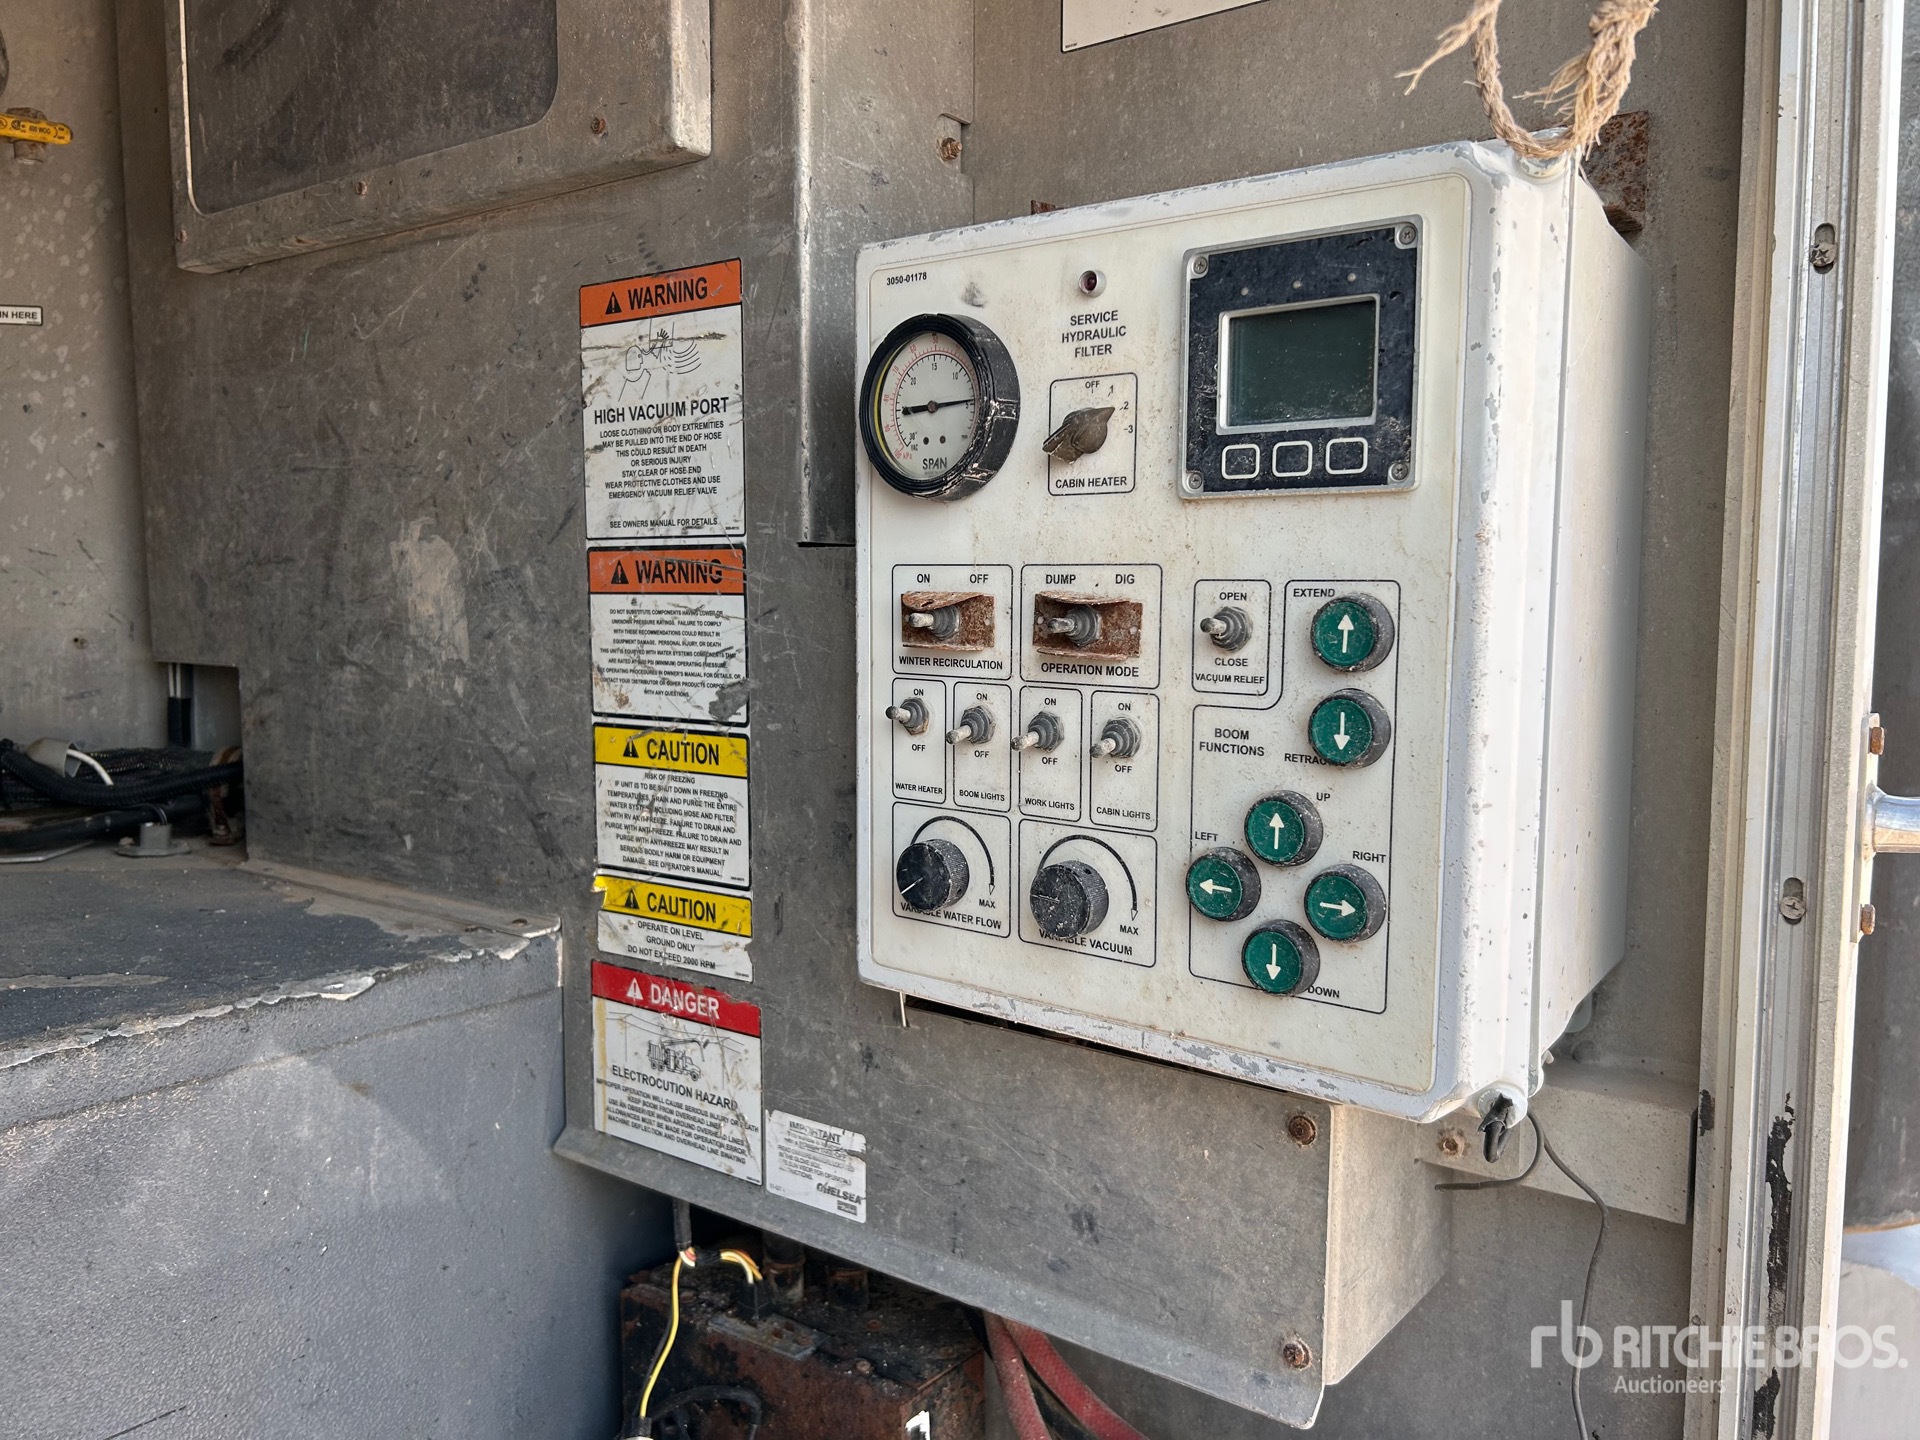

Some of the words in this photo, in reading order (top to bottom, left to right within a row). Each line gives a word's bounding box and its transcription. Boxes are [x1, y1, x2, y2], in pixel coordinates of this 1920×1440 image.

[887, 272, 927, 286] 3050-01178
[628, 277, 707, 310] WARNING
[11, 311, 38, 319] HERE
[1070, 310, 1119, 326] SERVICE
[1061, 326, 1127, 343] HYDRAULIC
[1074, 344, 1112, 358] FILTER
[931, 362, 938, 371] 15
[952, 372, 958, 381] 10
[1085, 381, 1100, 390] OFF
[1109, 385, 1114, 394] 1
[594, 407, 625, 425] HIGH
[629, 401, 686, 421] VACUUM
[691, 396, 729, 415] PORT
[1123, 401, 1129, 410] 2
[600, 430, 620, 438] LOOSE
[621, 427, 652, 437] CLOTHING
[652, 426, 662, 434] OR
[663, 424, 681, 433] BODY
[682, 420, 724, 431] EXTREMITIES
[1127, 425, 1134, 434] 3
[602, 440, 614, 448] MAY
[625, 438, 648, 446] PULLED
[650, 436, 664, 445] INTO
[665, 435, 678, 443] THE
[679, 434, 692, 442] END
[694, 433, 702, 441] OF
[704, 431, 722, 440] HOSE
[616, 449, 630, 458] THIS
[630, 447, 652, 457] COULD
[653, 446, 677, 455] RESULT
[678, 445, 684, 453] IN
[686, 444, 707, 453] DEATH
[630, 459, 640, 467] OR
[641, 457, 668, 467] SERIOUS
[669, 455, 691, 465] INJURY
[922, 457, 948, 470] SPAN
[622, 470, 637, 478] STAY
[637, 468, 658, 477] CLEAR
[660, 467, 668, 476] OF
[669, 466, 687, 475] HOSE
[688, 465, 702, 474] END
[605, 481, 623, 489] WEAR
[624, 478, 661, 488] PROTECTIVE
[662, 477, 692, 486] CLOTHES
[692, 476, 707, 485] AND
[707, 475, 721, 484] USE
[1055, 478, 1085, 489] CABIN
[1088, 476, 1127, 487] HEATER
[609, 490, 646, 499] EMERGENCY
[647, 488, 672, 498] VACUUM
[674, 487, 696, 496] RELIEF
[697, 486, 718, 495] VALVE
[610, 520, 621, 529] SEE
[622, 519, 649, 528] OWNERS
[650, 518, 676, 527] MANUAL
[677, 518, 690, 527] FOR
[691, 517, 718, 526] DETAILS
[635, 559, 723, 584] WARNING
[917, 574, 931, 584] ON
[969, 574, 989, 584] OFF
[1045, 574, 1076, 585] DUMP
[1115, 574, 1135, 585] DIG
[1219, 592, 1247, 601] OPEN
[1293, 588, 1335, 598] EXTEND
[898, 656, 931, 667] WINTER
[933, 657, 1003, 670] RECIRCULATION
[1214, 657, 1248, 667] CLOSE
[1041, 662, 1102, 676] OPERATION
[1105, 665, 1139, 677] MODE
[1195, 673, 1232, 683] VACUUM
[1234, 675, 1265, 684] RELIEF
[913, 688, 924, 697] ON
[976, 692, 988, 701] ON
[1044, 697, 1057, 706] ON
[1118, 703, 1131, 712] ON
[1214, 728, 1250, 740] BOOM
[647, 738, 719, 766] CAUTION
[911, 743, 926, 752] OFF
[1199, 741, 1265, 757] FUNCTIONS
[974, 750, 989, 759] OFF
[1041, 756, 1058, 766] OFF
[1284, 753, 1332, 766] RETRAC
[1114, 764, 1132, 774] OFF
[644, 772, 658, 780] RISK
[658, 773, 666, 781] OF
[667, 774, 696, 784] FREEZING
[649, 783, 657, 791] BE
[657, 784, 673, 793] SHUT
[673, 786, 692, 795] DOWN
[692, 788, 699, 796] IN
[700, 789, 729, 799] FREEZING
[895, 782, 917, 792] WATER
[917, 784, 943, 795] HEATER
[959, 789, 980, 800] BOOM
[980, 791, 1005, 802] LIGHTS
[1316, 792, 1331, 802] UP
[1025, 797, 1048, 807] WORK
[1049, 800, 1075, 811] LIGHTS
[1096, 806, 1121, 817] CABIN
[1122, 809, 1151, 820] LIGHTS
[1195, 831, 1218, 842] LEFT
[620, 844, 644, 854] SERIOUS
[644, 847, 664, 857] BODILY
[664, 850, 682, 860] HARM
[682, 853, 691, 861] OR
[692, 855, 726, 866] EQUIPMENT
[1352, 851, 1387, 863] RIGHT
[647, 892, 716, 923] CAUTION
[978, 899, 996, 909] MAX
[943, 910, 974, 925] WATER
[975, 916, 1002, 930] FLOW
[637, 920, 669, 934] OPERATE
[670, 926, 681, 935] ON
[682, 929, 704, 941] LEVEL
[1119, 924, 1139, 936] MAX
[646, 935, 675, 949] GROUND
[676, 940, 696, 952] ONLY
[1089, 938, 1133, 956] VACUUM
[627, 944, 637, 953] DO
[638, 946, 653, 956] NOT
[654, 949, 682, 963] EXCEED
[683, 956, 699, 967] 2000
[700, 959, 716, 970] RPM
[1307, 985, 1340, 998] DOWN
[650, 983, 720, 1020] DANGER
[612, 1064, 693, 1098] ELECTROCUTION
[695, 1088, 739, 1112] HAZARD
[789, 1121, 841, 1143] IMPORTANT
[816, 1182, 861, 1205] CHELSEA
